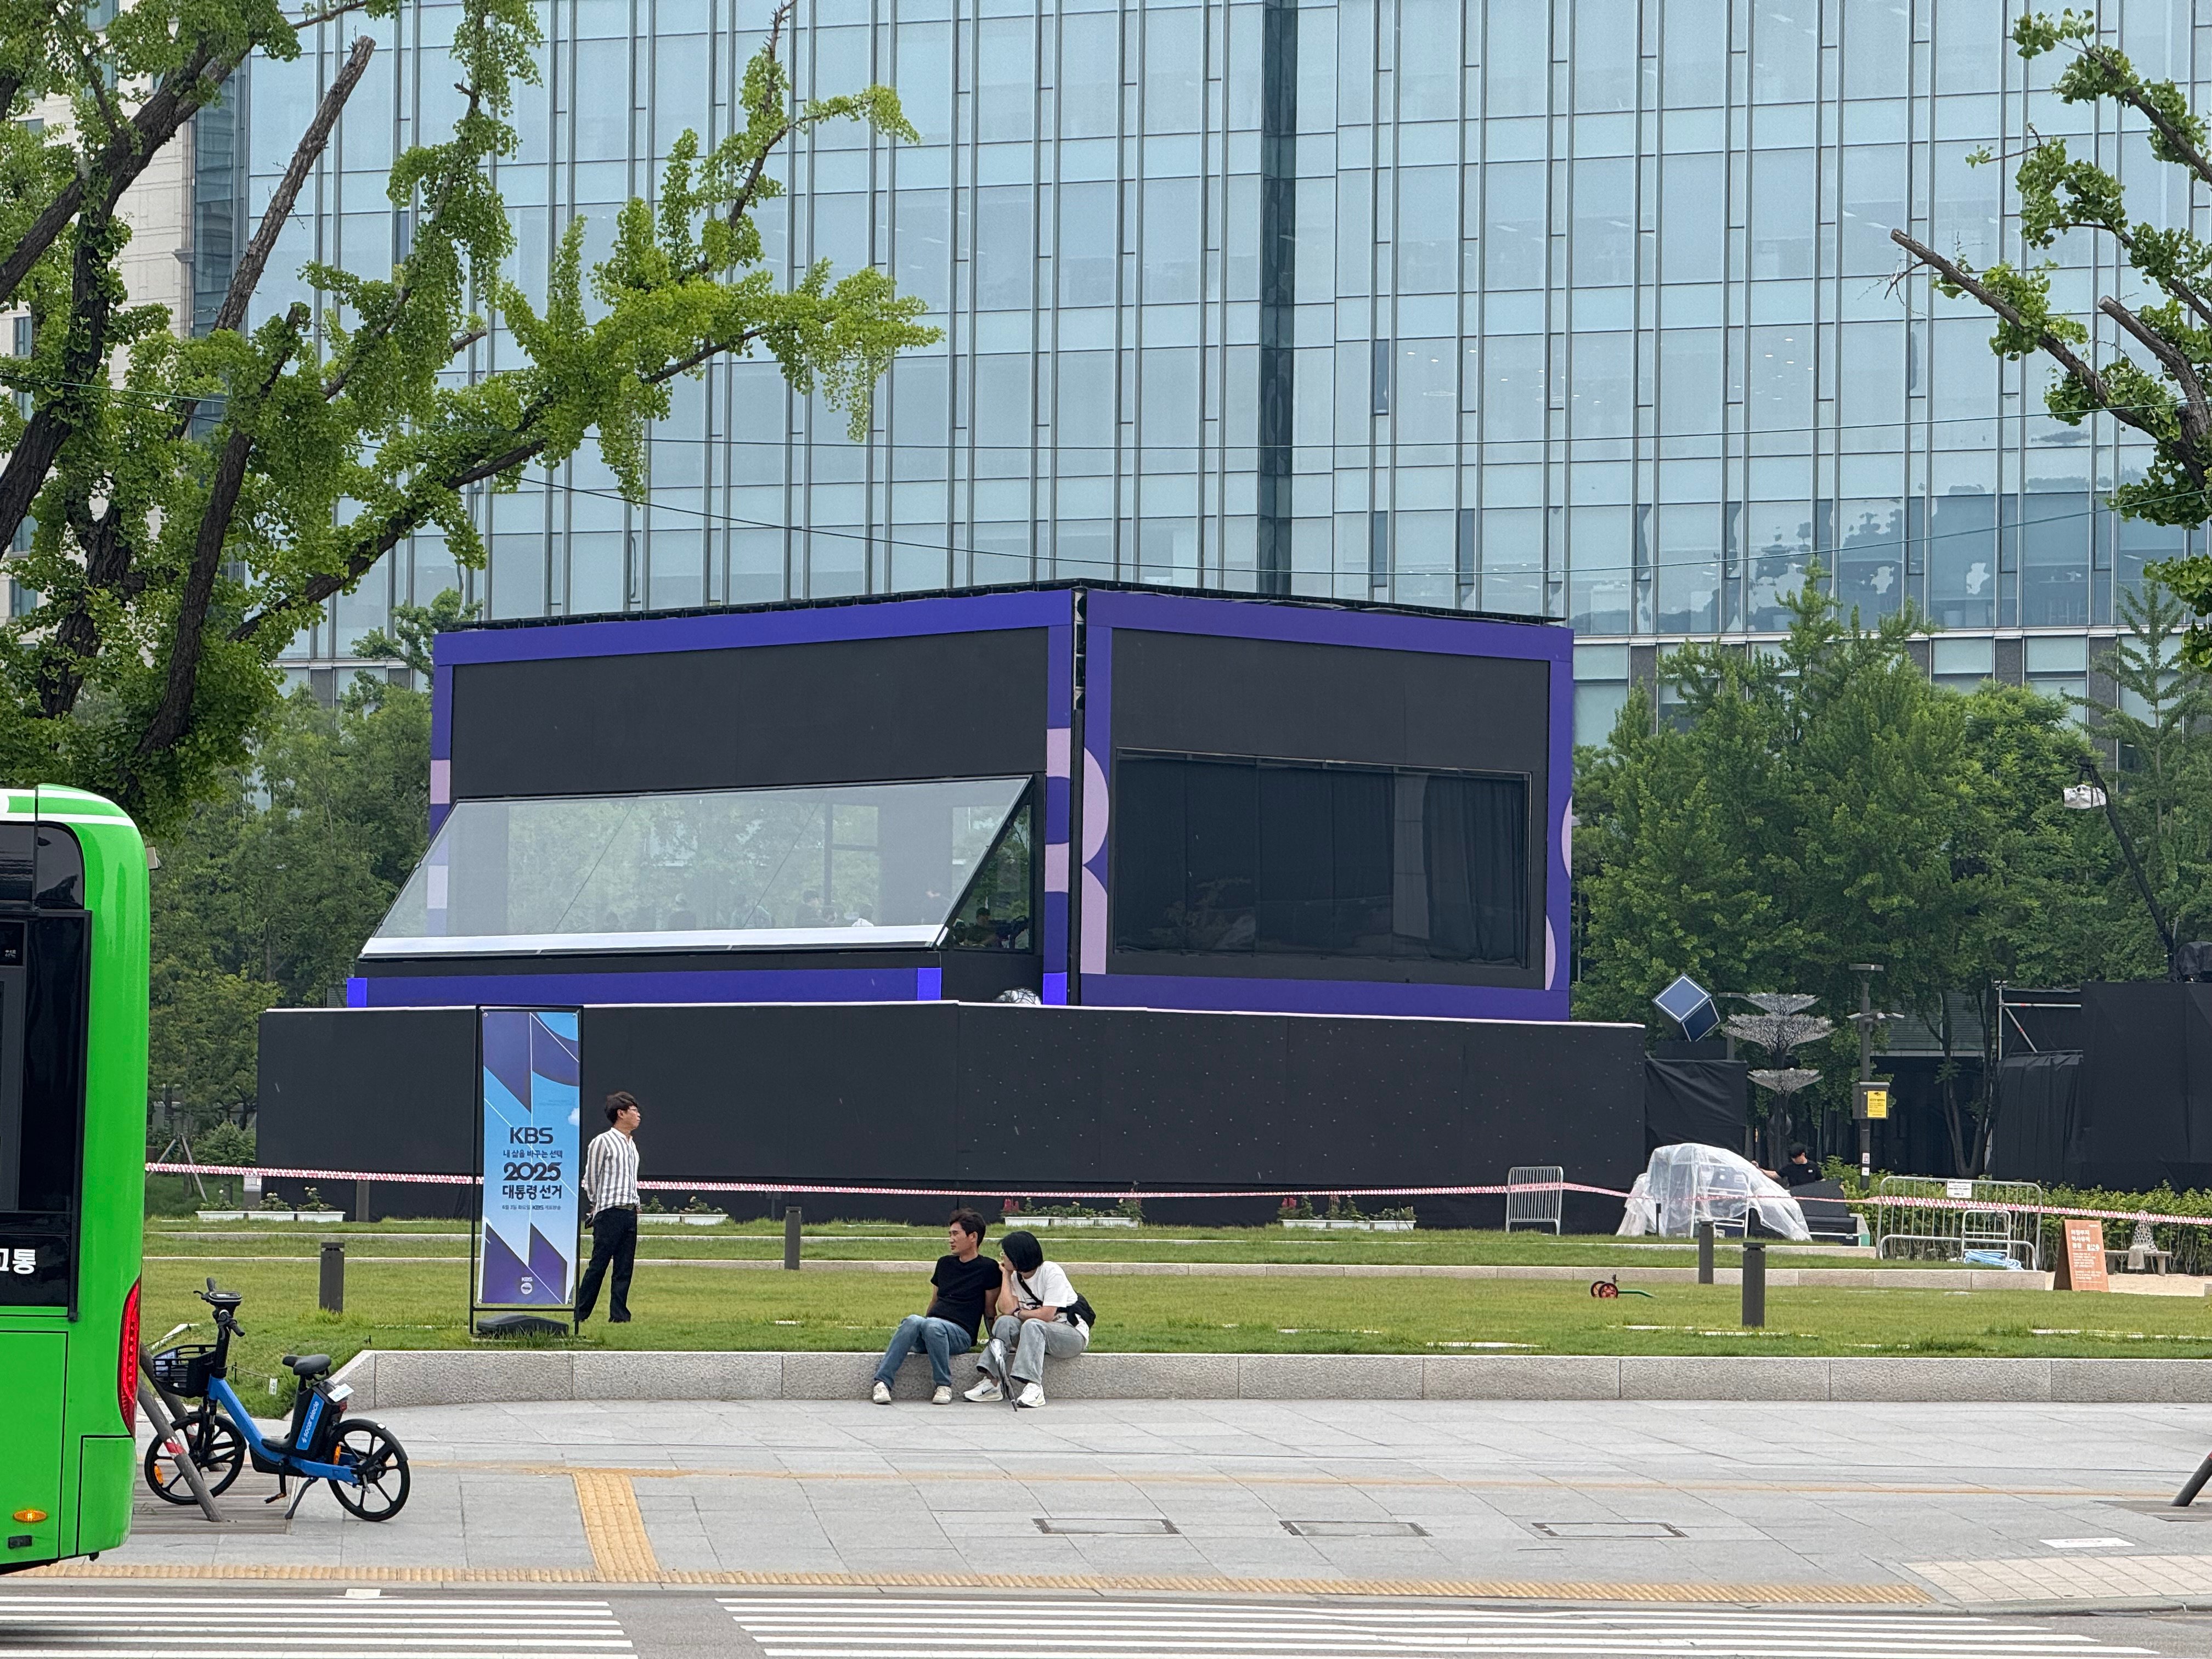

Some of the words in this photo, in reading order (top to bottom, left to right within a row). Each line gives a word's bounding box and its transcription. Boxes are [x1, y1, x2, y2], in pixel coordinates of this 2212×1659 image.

[510, 1127, 554, 1144] KBS
[503, 1149, 510, 1158] 내
[511, 1149, 525, 1158] 삶을
[527, 1149, 548, 1158] 바꾸는
[550, 1149, 563, 1158] 선택
[503, 1161, 562, 1181] 2025
[502, 1184, 537, 1200] 대통령
[539, 1184, 562, 1199] 선거
[304, 1418, 313, 1438] socar
